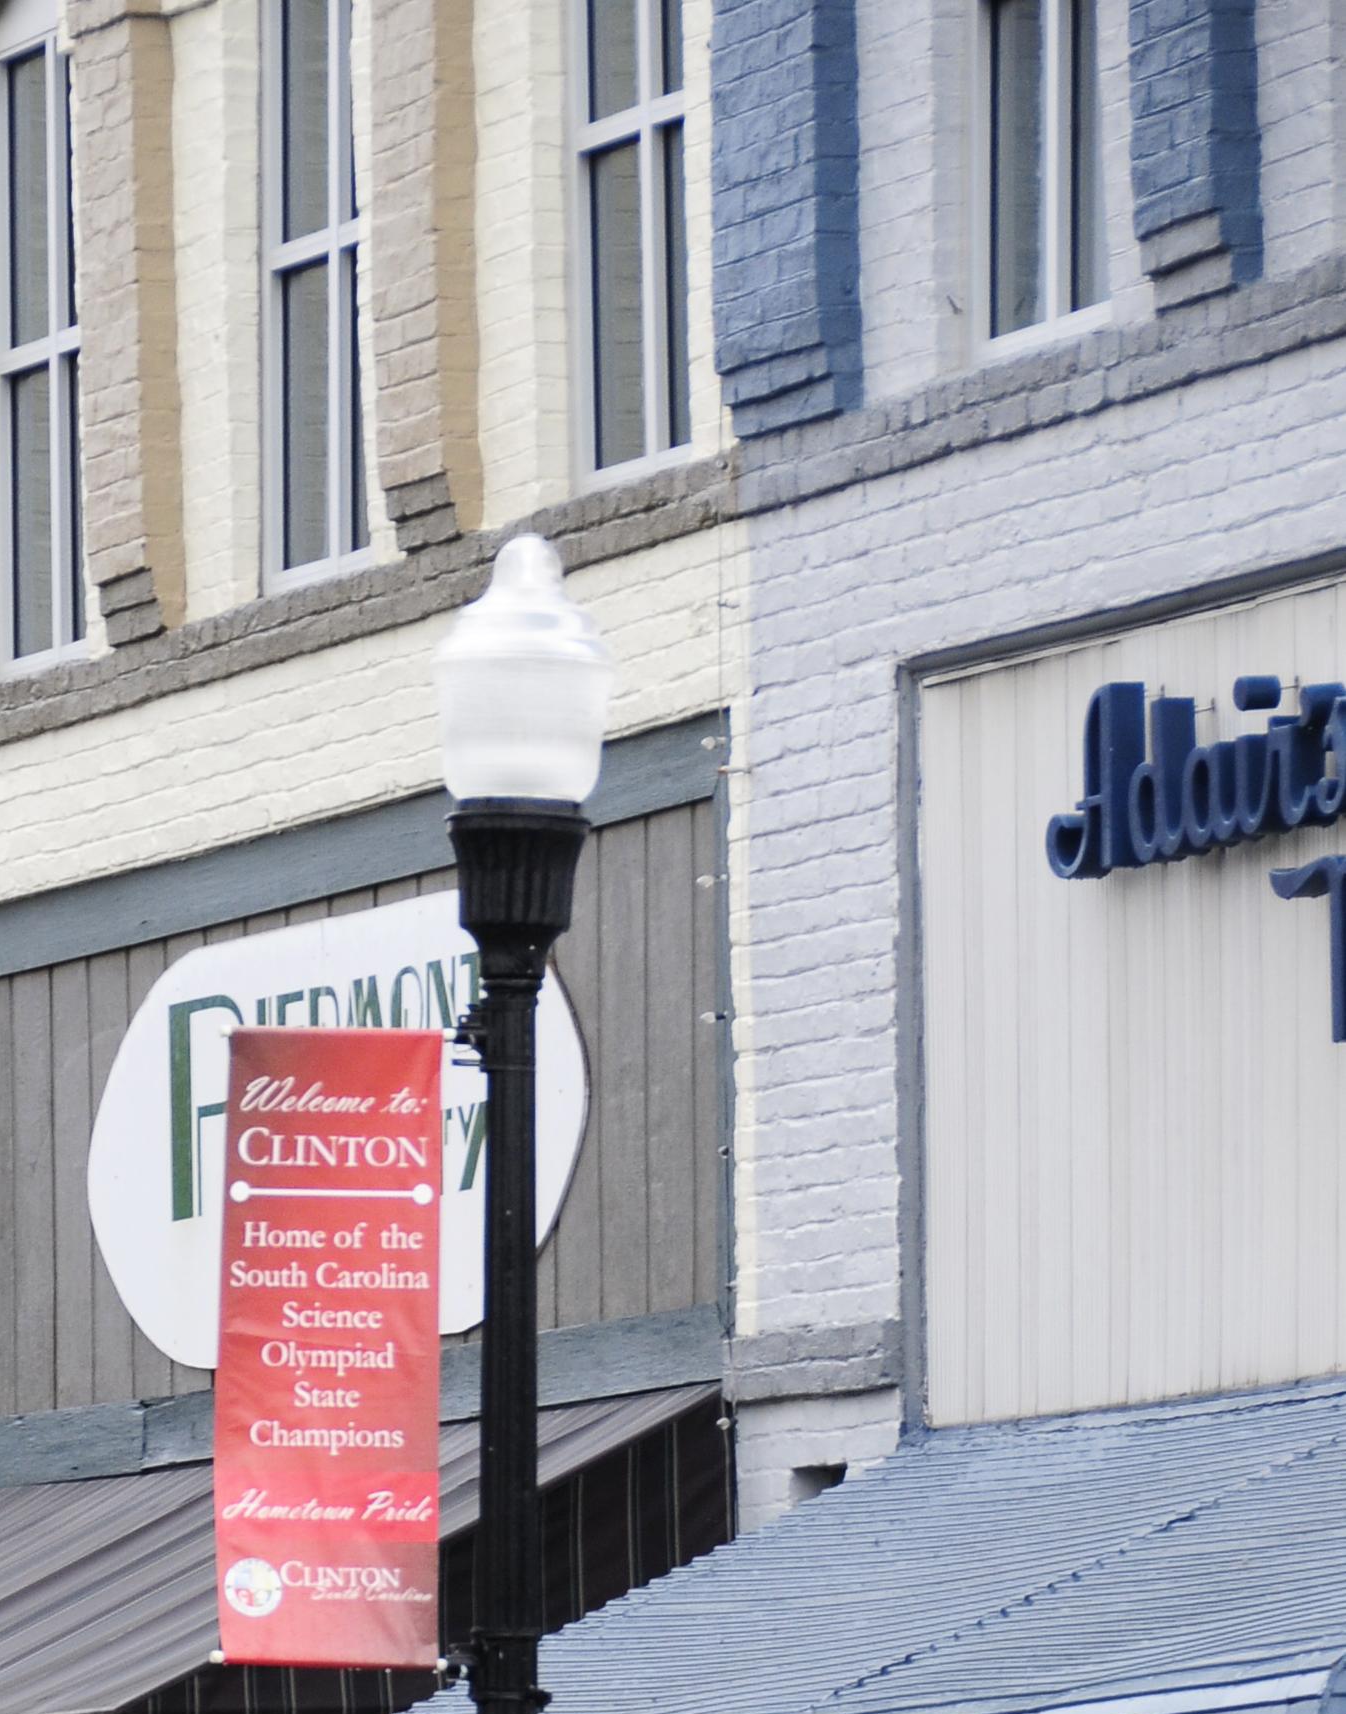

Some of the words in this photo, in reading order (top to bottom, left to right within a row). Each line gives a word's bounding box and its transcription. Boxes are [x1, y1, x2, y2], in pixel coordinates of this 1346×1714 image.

[239, 1076, 376, 1114] Welcome
[379, 1087, 428, 1114] to:
[237, 1127, 429, 1168] CLINTON
[242, 1221, 326, 1249] Home
[333, 1222, 367, 1249] of
[381, 1224, 424, 1250] the
[230, 1261, 308, 1288] South
[315, 1263, 429, 1289] Carolina
[282, 1301, 383, 1329] Science
[261, 1341, 395, 1377] Olympiad
[293, 1381, 361, 1409] State
[249, 1420, 405, 1456] Champions
[222, 1488, 356, 1521] Hometown
[361, 1491, 434, 1522] Pride
[279, 1560, 401, 1588] CLINTON
